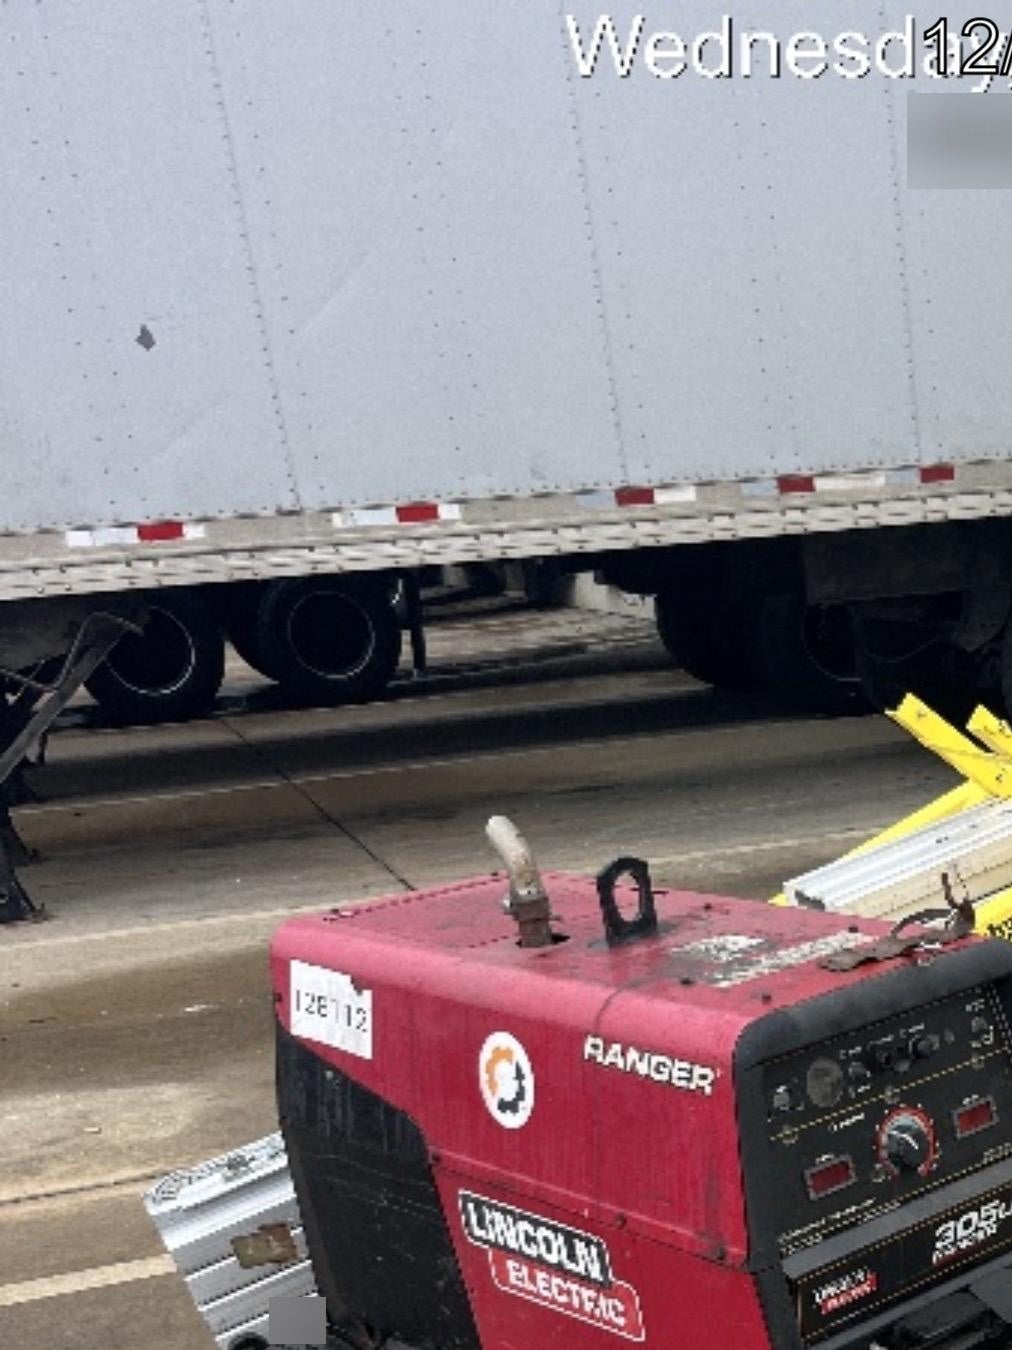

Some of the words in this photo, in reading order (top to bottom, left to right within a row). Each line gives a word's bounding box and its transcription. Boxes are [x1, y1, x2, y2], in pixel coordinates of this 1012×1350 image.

[584, 1034, 715, 1096] RANGER
[466, 1202, 605, 1282] LINCOLN
[505, 1258, 627, 1327] ELECTRIC
